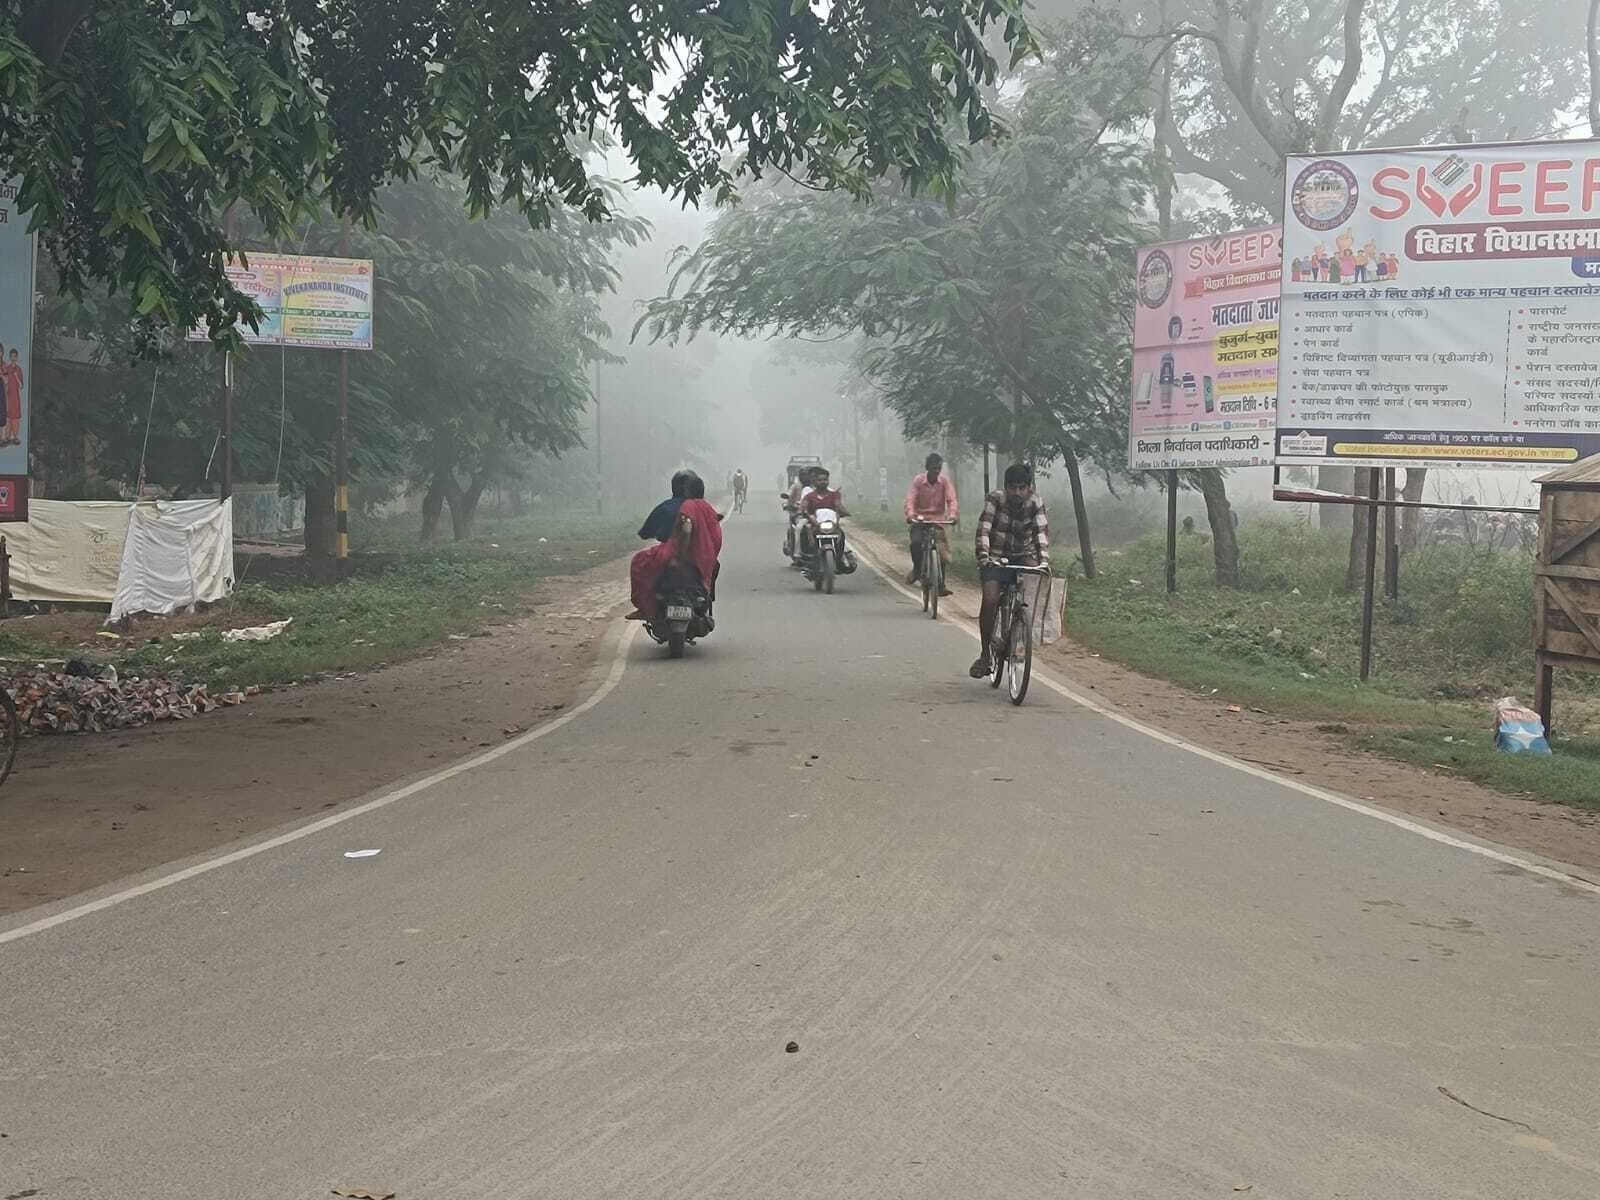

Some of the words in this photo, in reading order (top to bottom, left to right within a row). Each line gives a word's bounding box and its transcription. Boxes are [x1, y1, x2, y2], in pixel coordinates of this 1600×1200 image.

[1414, 228, 1476, 255] बिहार
[1189, 234, 1274, 269] SWEEP
[1203, 276, 1224, 289] बिहार
[1226, 271, 1266, 286] विधानसभा
[1303, 291, 1338, 300] मतदान
[1342, 288, 1366, 299] करने
[1369, 288, 1381, 299] के
[1385, 287, 1408, 299] लिए
[1411, 286, 1435, 299] कोई
[1438, 287, 1451, 298] भी
[1455, 288, 1475, 297] एक
[1479, 288, 1507, 297] मान्य
[1510, 287, 1550, 297] पहचान
[1210, 300, 1253, 326] मतदाता
[1304, 309, 1338, 318] मतदाता
[1342, 309, 1371, 318] पहचान
[1374, 310, 1388, 318] पत्र
[1529, 305, 1567, 316] पासपोर्ट
[1304, 325, 1330, 333] आधार
[1334, 323, 1353, 333] कार्ड
[1320, 338, 1340, 347] कार्ड
[1217, 349, 1257, 362] मतदान
[1380, 353, 1411, 362] पहचान
[1323, 368, 1352, 377] पहचान
[1137, 440, 1161, 453] जिला
[1164, 438, 1202, 453] निर्वाचन
[1204, 434, 1259, 451] पदाधिकारी
